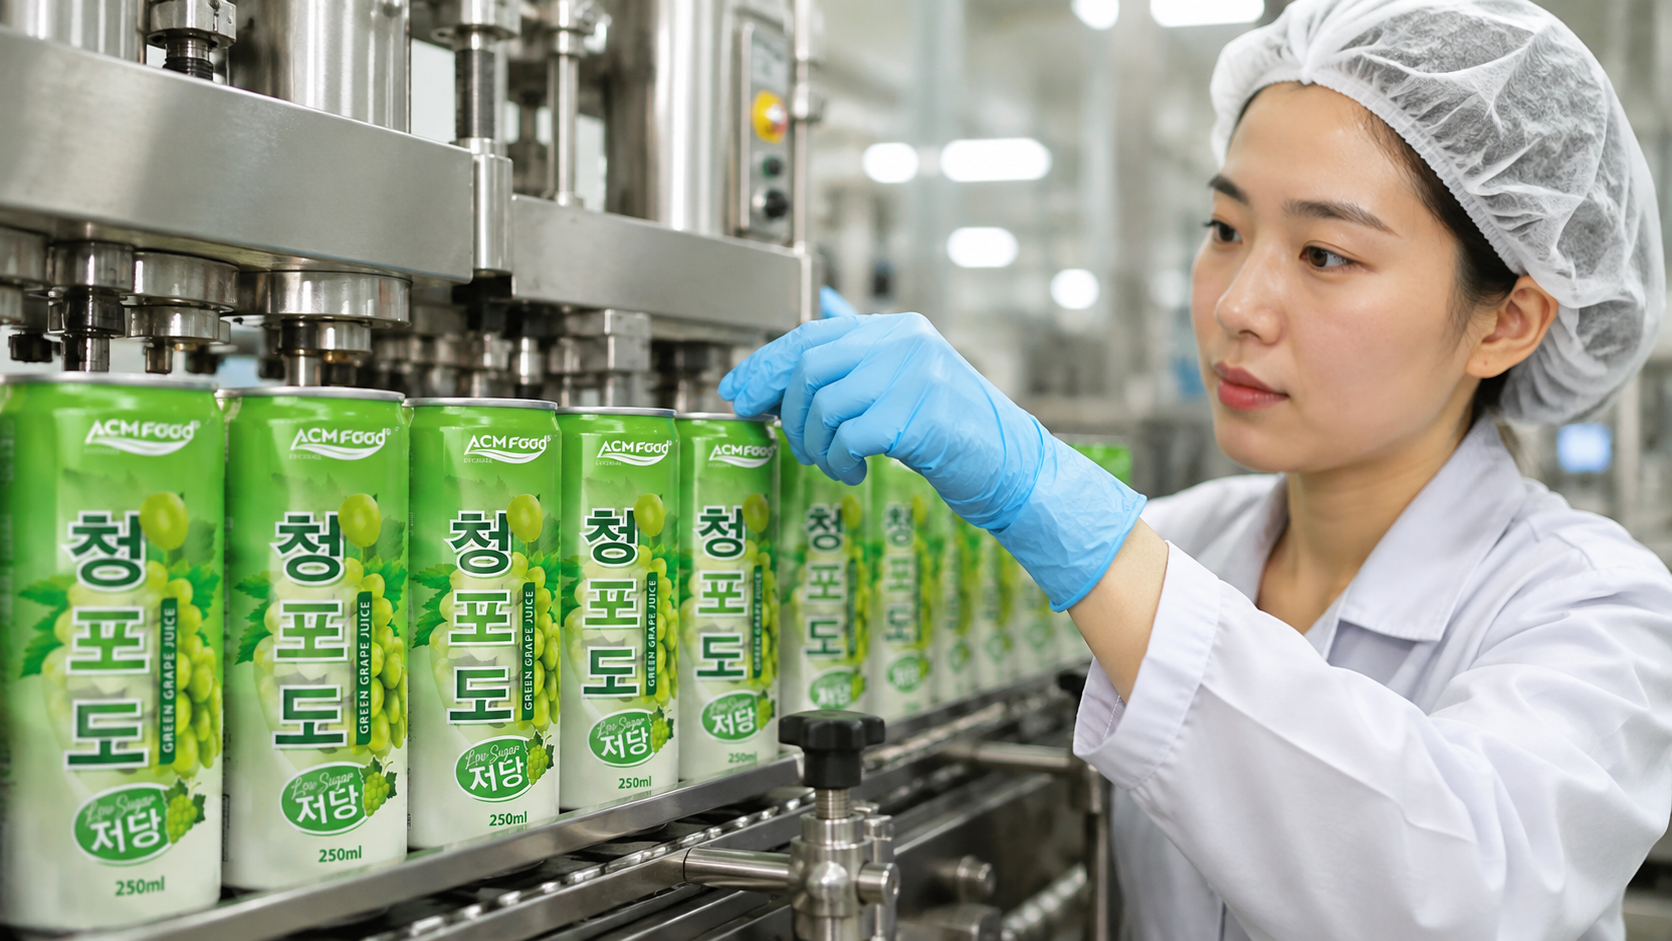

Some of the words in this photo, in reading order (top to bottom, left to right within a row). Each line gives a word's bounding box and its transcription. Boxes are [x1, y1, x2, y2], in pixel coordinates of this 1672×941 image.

[525, 591, 534, 624] JUICE
[579, 508, 640, 697] 청포도
[648, 580, 656, 610] JUICE
[694, 506, 748, 679] 청포도
[164, 608, 176, 648] JUICE
[269, 512, 349, 747] 청포도
[360, 602, 370, 638] JUICE
[444, 511, 515, 724] 청포도
[648, 613, 656, 648] GRAPE
[61, 511, 150, 770] 청포도
[524, 628, 534, 666] GRAPE
[163, 652, 176, 700] GRAPE
[360, 643, 370, 686] GRAPE
[648, 651, 656, 687] GREEN
[524, 671, 533, 710] GREEN
[163, 704, 176, 753] GREEN
[359, 690, 370, 734] GREEN
[712, 708, 756, 736] 저당
[600, 727, 648, 758] 저당
[728, 752, 758, 764] 250ml
[291, 776, 317, 800] Low
[317, 772, 354, 793] Sugar
[469, 756, 524, 792] 저당
[618, 776, 652, 790] 250ml
[296, 784, 360, 824] 저당
[489, 811, 528, 826] 250ml
[90, 808, 162, 853] 저당
[318, 846, 362, 862] 250ml
[115, 876, 165, 896] 250ml
